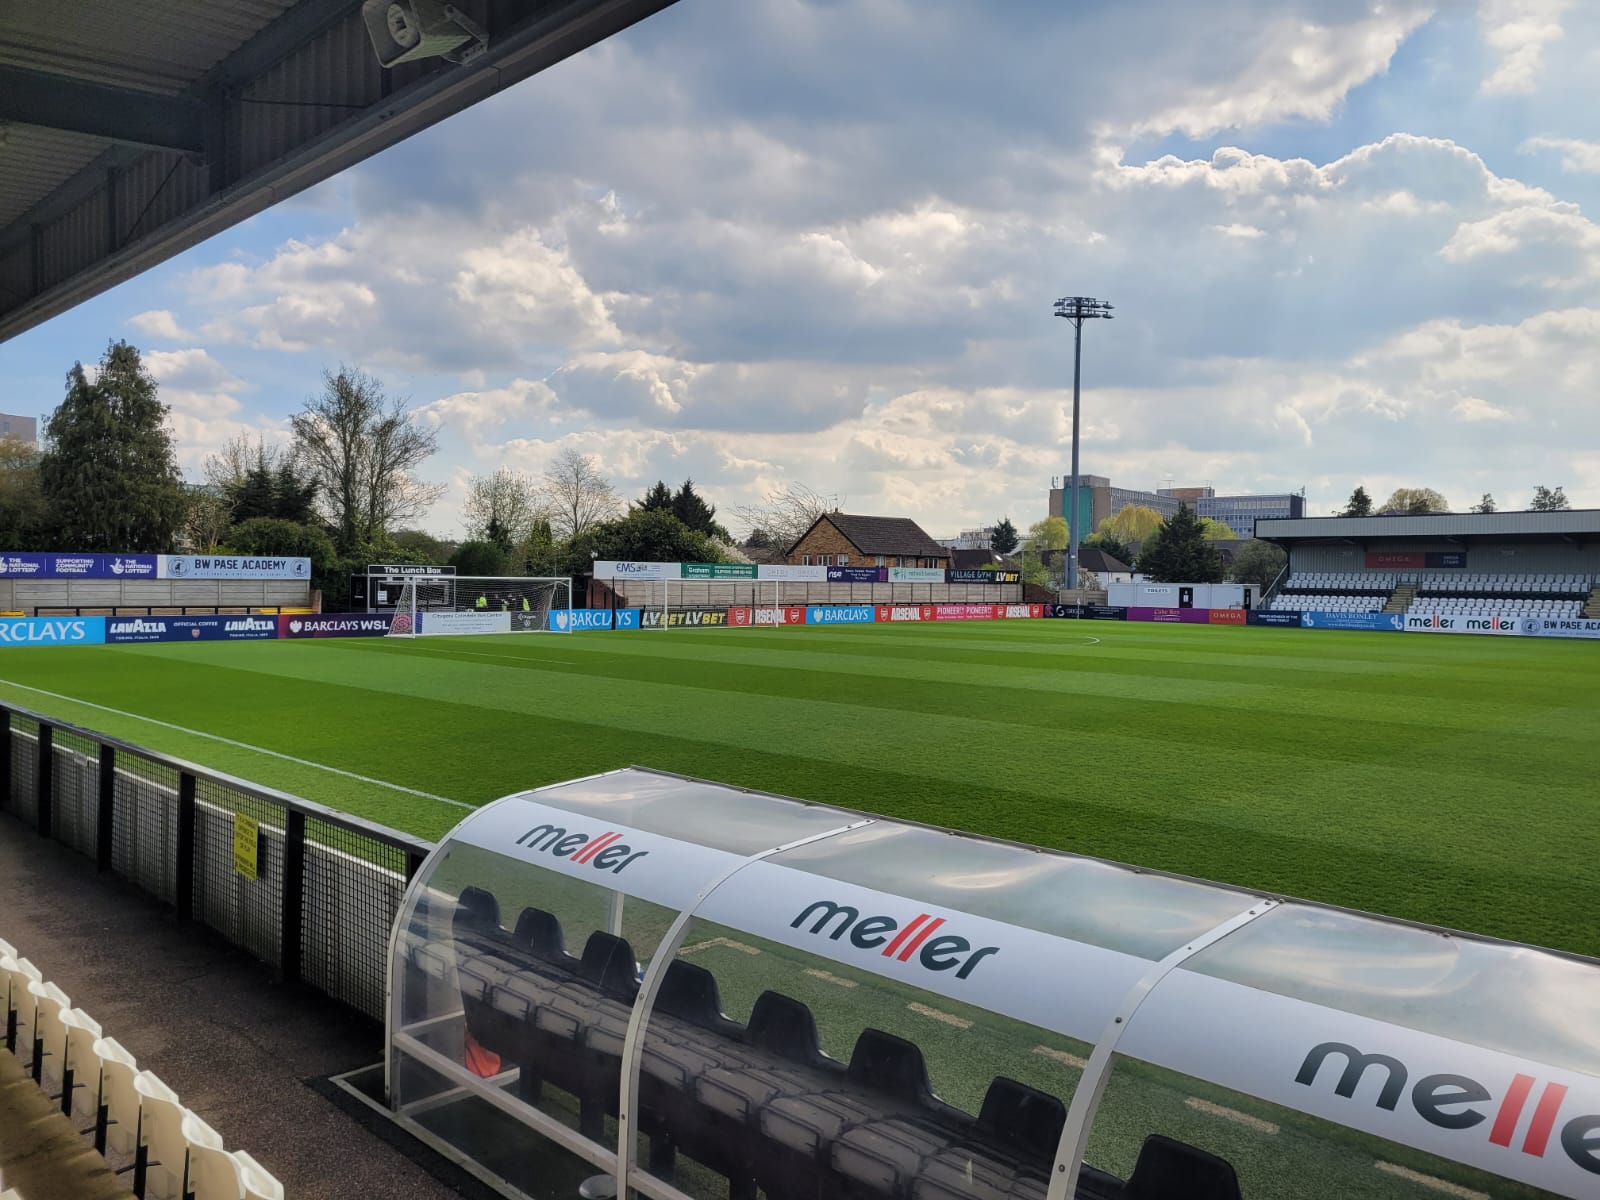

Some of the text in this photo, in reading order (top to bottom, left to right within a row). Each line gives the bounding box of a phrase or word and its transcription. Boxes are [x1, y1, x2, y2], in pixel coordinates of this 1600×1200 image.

[194, 560, 287, 570] BW PASE ACADEMY
[616, 562, 636, 572] EMS
[825, 609, 868, 620] BARCLAYS
[891, 608, 921, 621] ARSENAL
[1006, 605, 1030, 618] ARSENAL
[110, 619, 166, 633] LAVAZZA
[224, 618, 274, 631] LAVAZZA
[304, 620, 389, 631] BARCLAYS WSL
[1409, 614, 1455, 628] meller
[1467, 616, 1515, 631] meller
[1544, 620, 1557, 629] BW
[1560, 621, 1582, 630] PASE
[515, 824, 650, 874] meller
[790, 900, 1000, 980] meller
